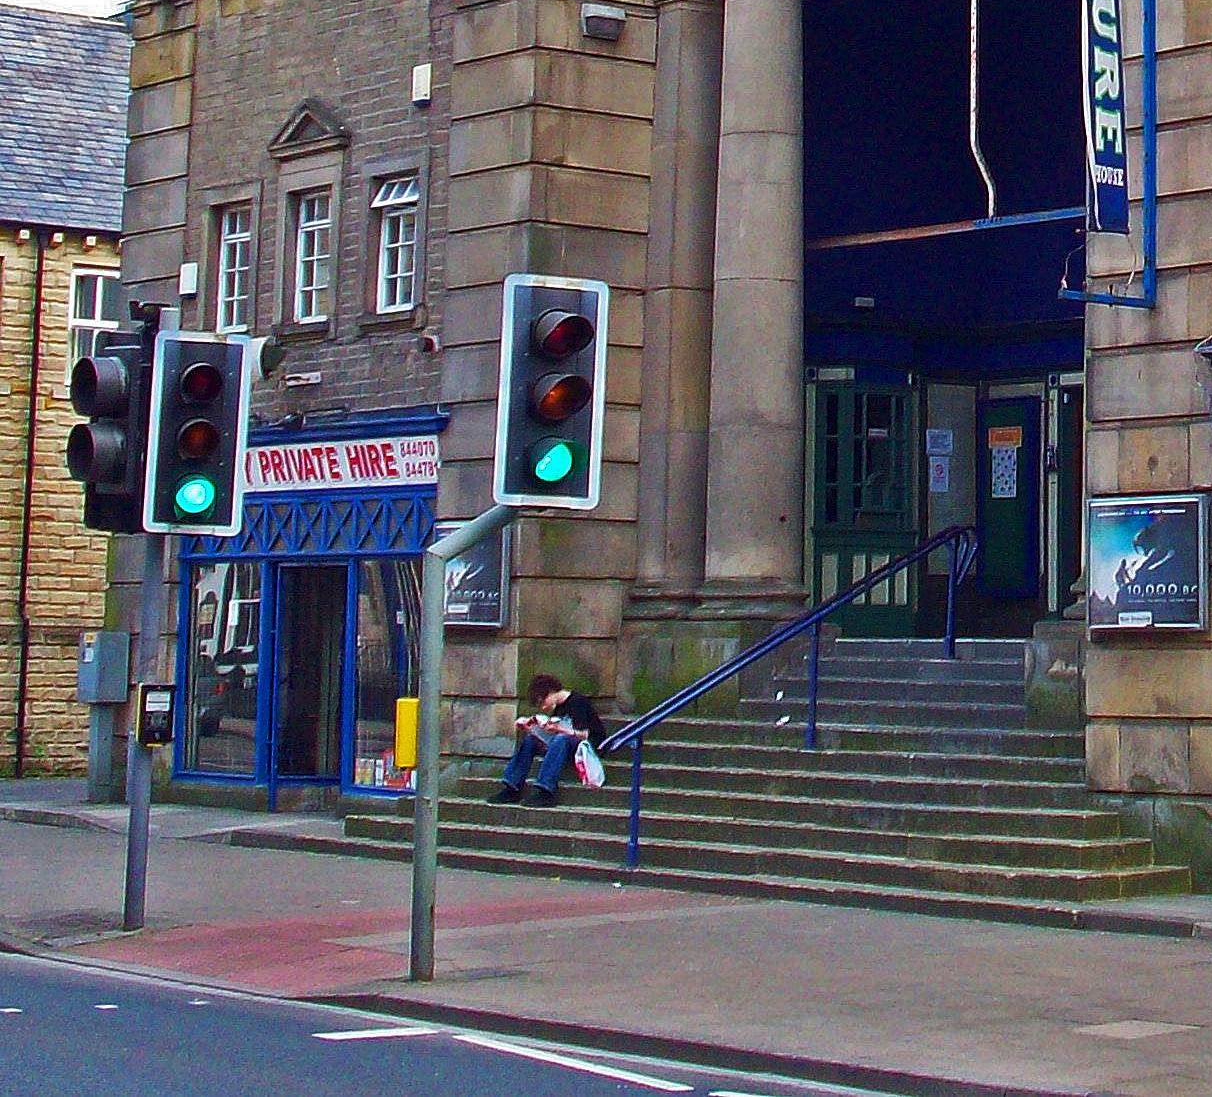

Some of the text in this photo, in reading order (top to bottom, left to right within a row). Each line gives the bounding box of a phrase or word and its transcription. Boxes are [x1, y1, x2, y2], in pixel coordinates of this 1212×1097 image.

[259, 446, 342, 484] PRIVATE
[345, 443, 399, 479] HIRE
[1127, 584, 1177, 597] 10,000
